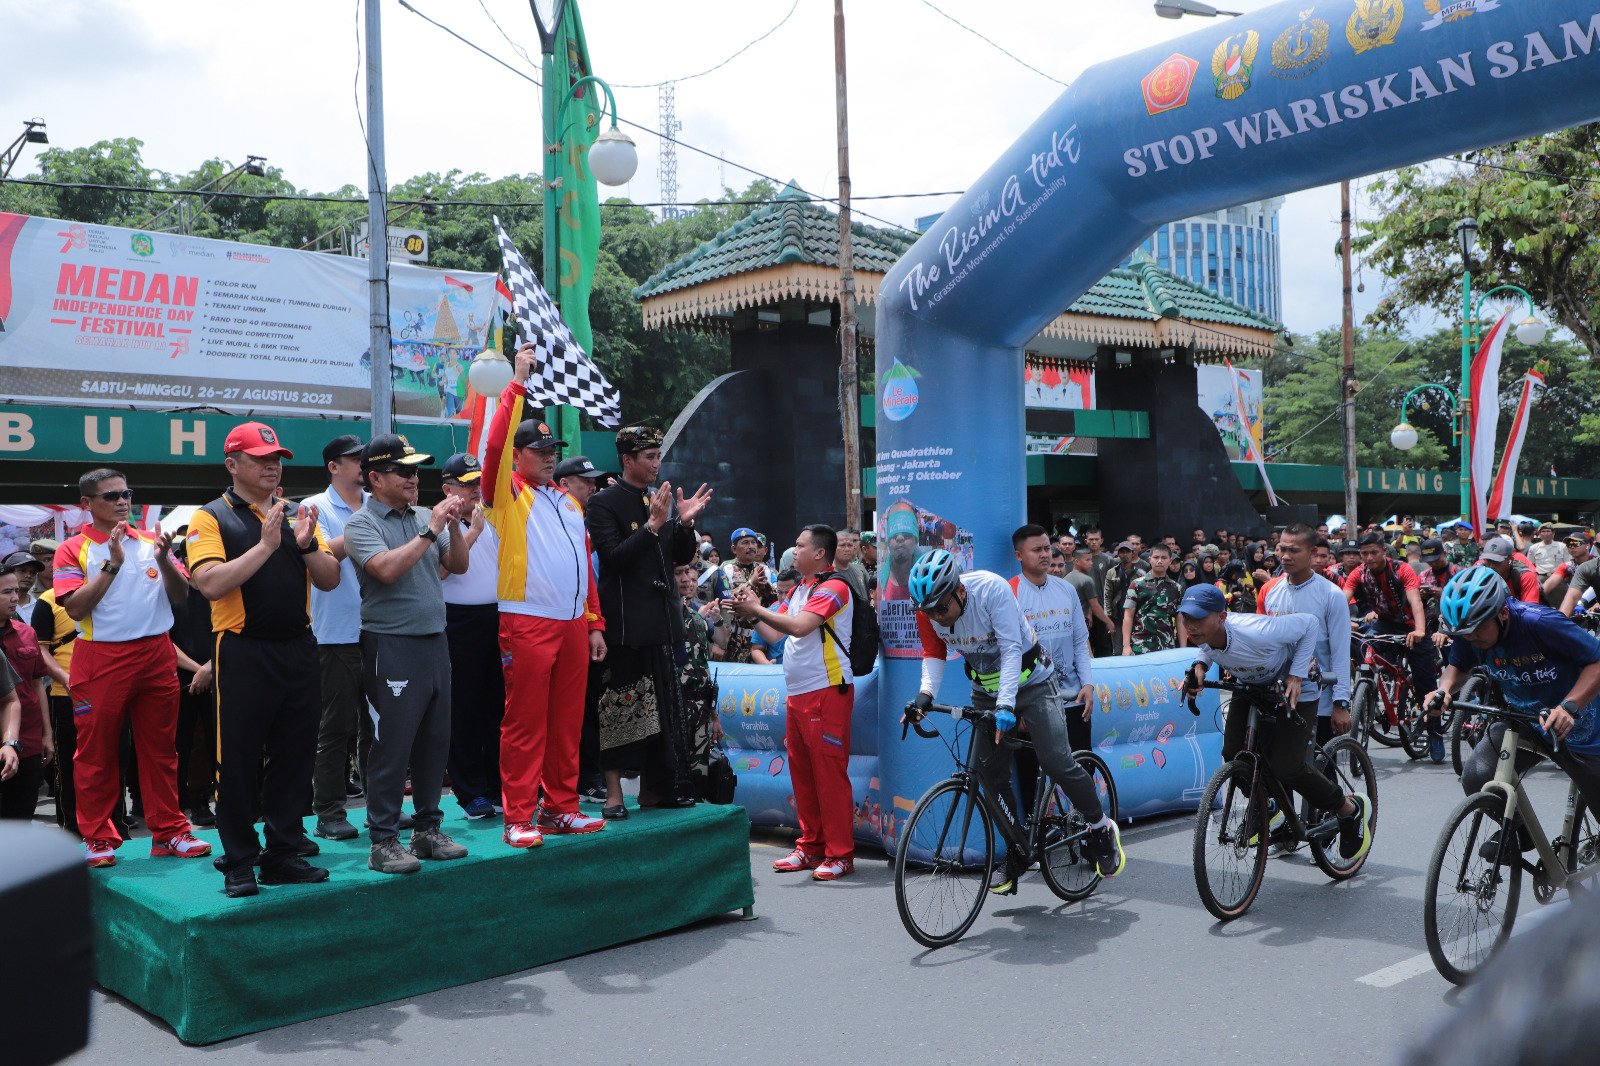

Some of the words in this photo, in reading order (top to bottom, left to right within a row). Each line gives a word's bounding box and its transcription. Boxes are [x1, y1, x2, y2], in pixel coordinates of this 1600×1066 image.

[1441, 0, 1476, 17] MPR-RI
[1123, 127, 1218, 178] STOP
[1223, 51, 1477, 150] WARISKAN
[407, 237, 423, 252] 88
[927, 298, 936, 309] A
[933, 268, 969, 303] Grassroot
[966, 233, 1007, 271] Movement
[1003, 221, 1017, 240] for
[1015, 174, 1067, 226] Sustainability
[56, 263, 199, 307] MEDAN
[214, 280, 239, 288] COLOR
[241, 282, 257, 290] RUN
[899, 262, 941, 311] The
[212, 291, 249, 300] SEMARAK
[251, 296, 281, 305] KULINER
[288, 300, 320, 309] TUMPENG
[322, 304, 347, 312] DURIAN
[212, 303, 241, 311] TENANT
[53, 298, 163, 320] INDEPENDENCE
[167, 308, 195, 323] DAY
[80, 317, 165, 338] FESTIVAL
[260, 321, 312, 331] PERFORMANCE
[209, 327, 243, 335] COOKING
[245, 331, 294, 340] COMPETITION
[225, 340, 251, 348] MURAL
[206, 350, 247, 359] DOORPRIZE
[274, 355, 308, 363] PULUHAN
[80, 380, 193, 399] SABTU-MINGGU,
[199, 386, 239, 399] 26-27
[243, 388, 299, 403] AGUSTUS
[302, 392, 333, 405] 2023
[892, 386, 903, 397] Le
[883, 394, 919, 408] Minerale
[901, 459, 941, 470] Jakarta
[907, 472, 914, 482] 5
[915, 470, 962, 481] Oktober
[889, 484, 911, 495] 2023
[1522, 478, 1568, 496] ANTI
